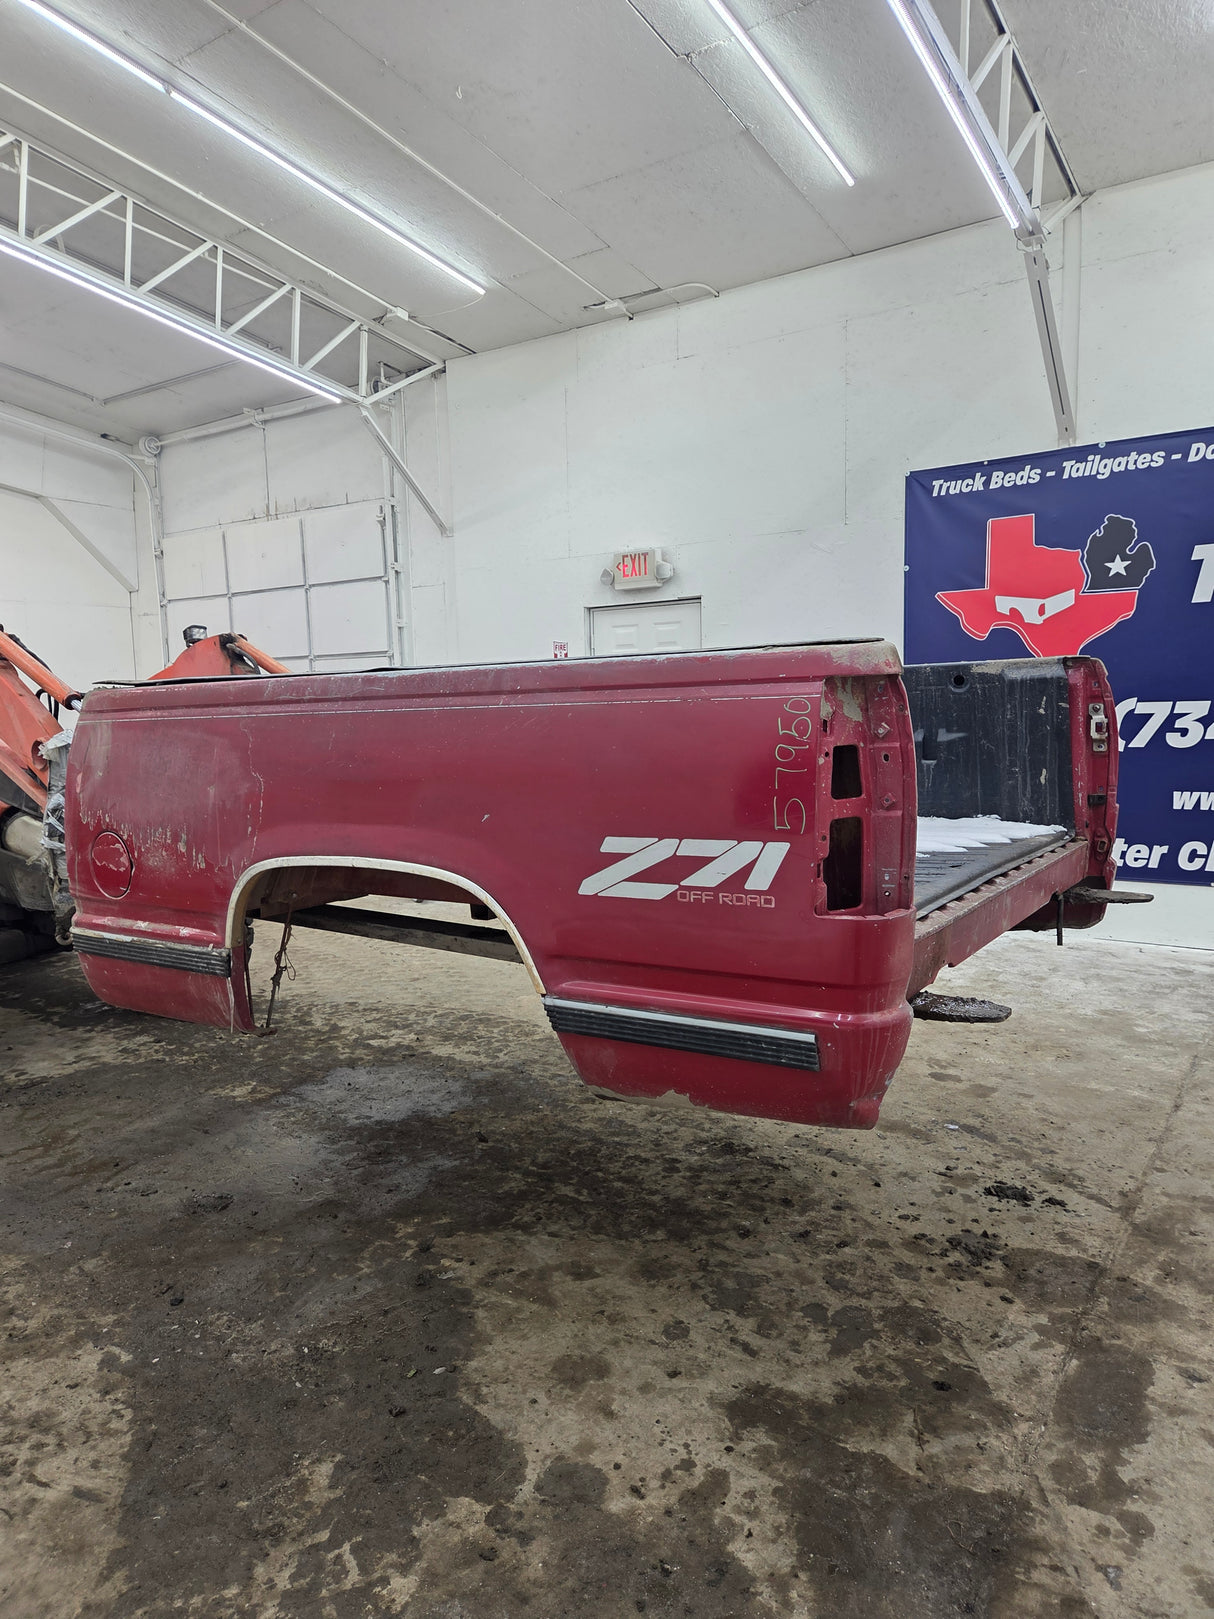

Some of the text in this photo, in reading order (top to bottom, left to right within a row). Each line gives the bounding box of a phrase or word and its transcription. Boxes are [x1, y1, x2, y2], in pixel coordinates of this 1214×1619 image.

[932, 472, 987, 497] Truck
[989, 465, 1041, 490] Beds
[1062, 450, 1165, 480] Tailgates
[622, 552, 649, 578] EXIT
[1115, 697, 1214, 752] (73
[578, 836, 791, 900] Z71
[676, 890, 775, 909] OFF ROAD
